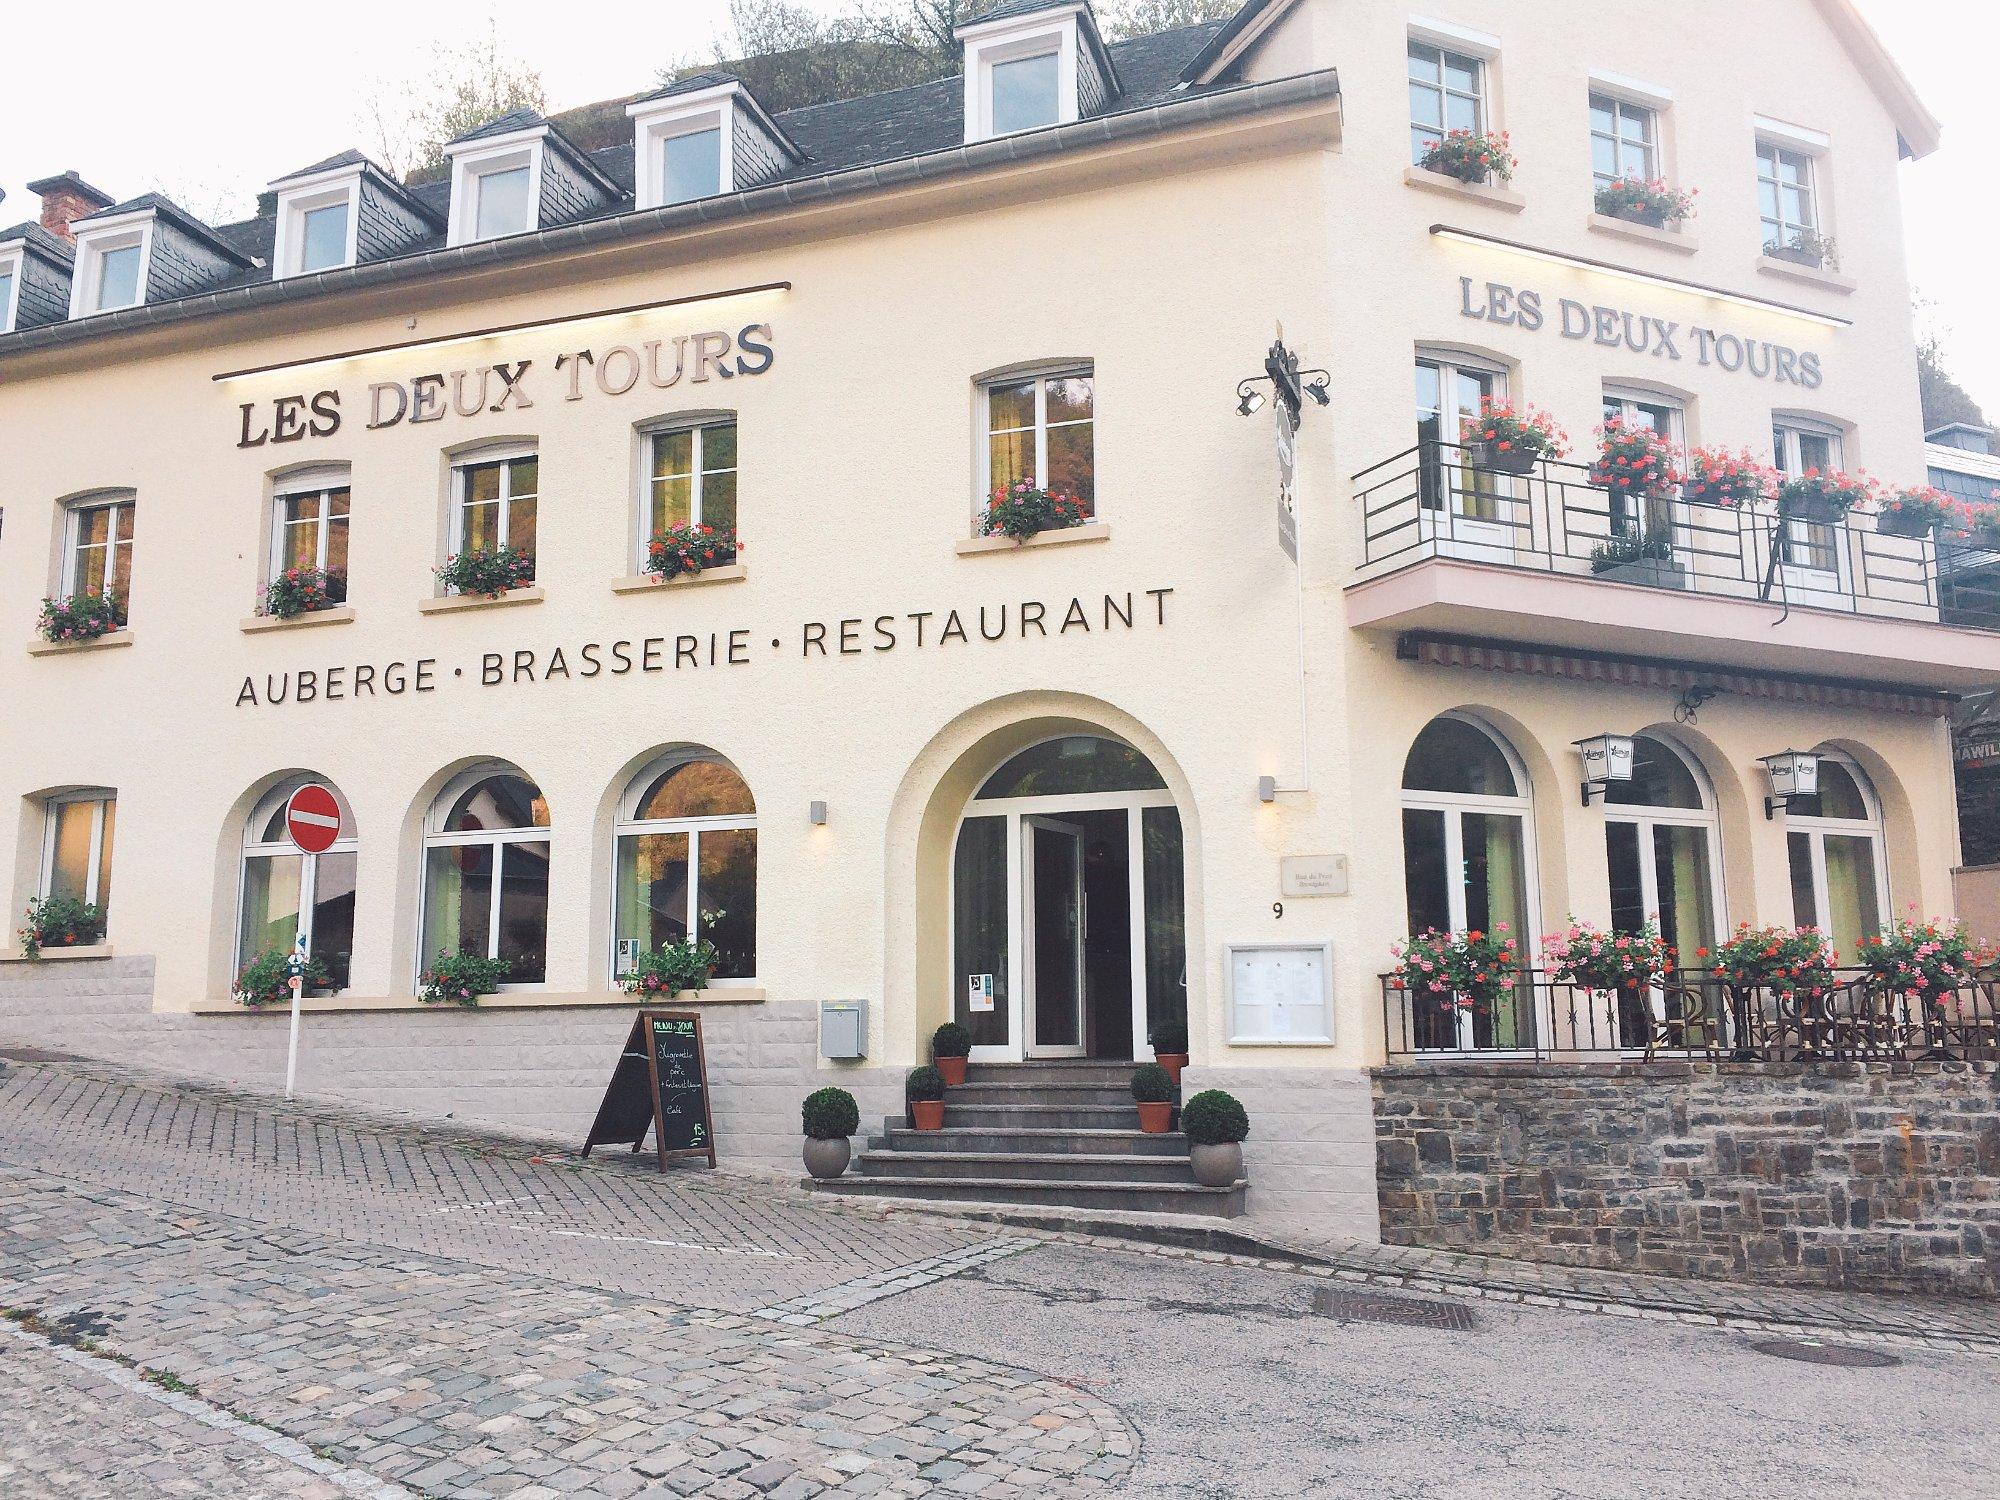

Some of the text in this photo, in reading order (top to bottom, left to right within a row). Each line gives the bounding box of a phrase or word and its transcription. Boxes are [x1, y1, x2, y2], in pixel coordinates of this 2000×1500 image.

[236, 322, 774, 448] LES DEUX TOURS
[1458, 276, 1824, 389] LES DEUX TOURS
[235, 587, 1176, 708] AUBERGE BRASSERIE RESTAURANT
[1272, 902, 1284, 919] 9
[653, 1021, 673, 1030] MENU
